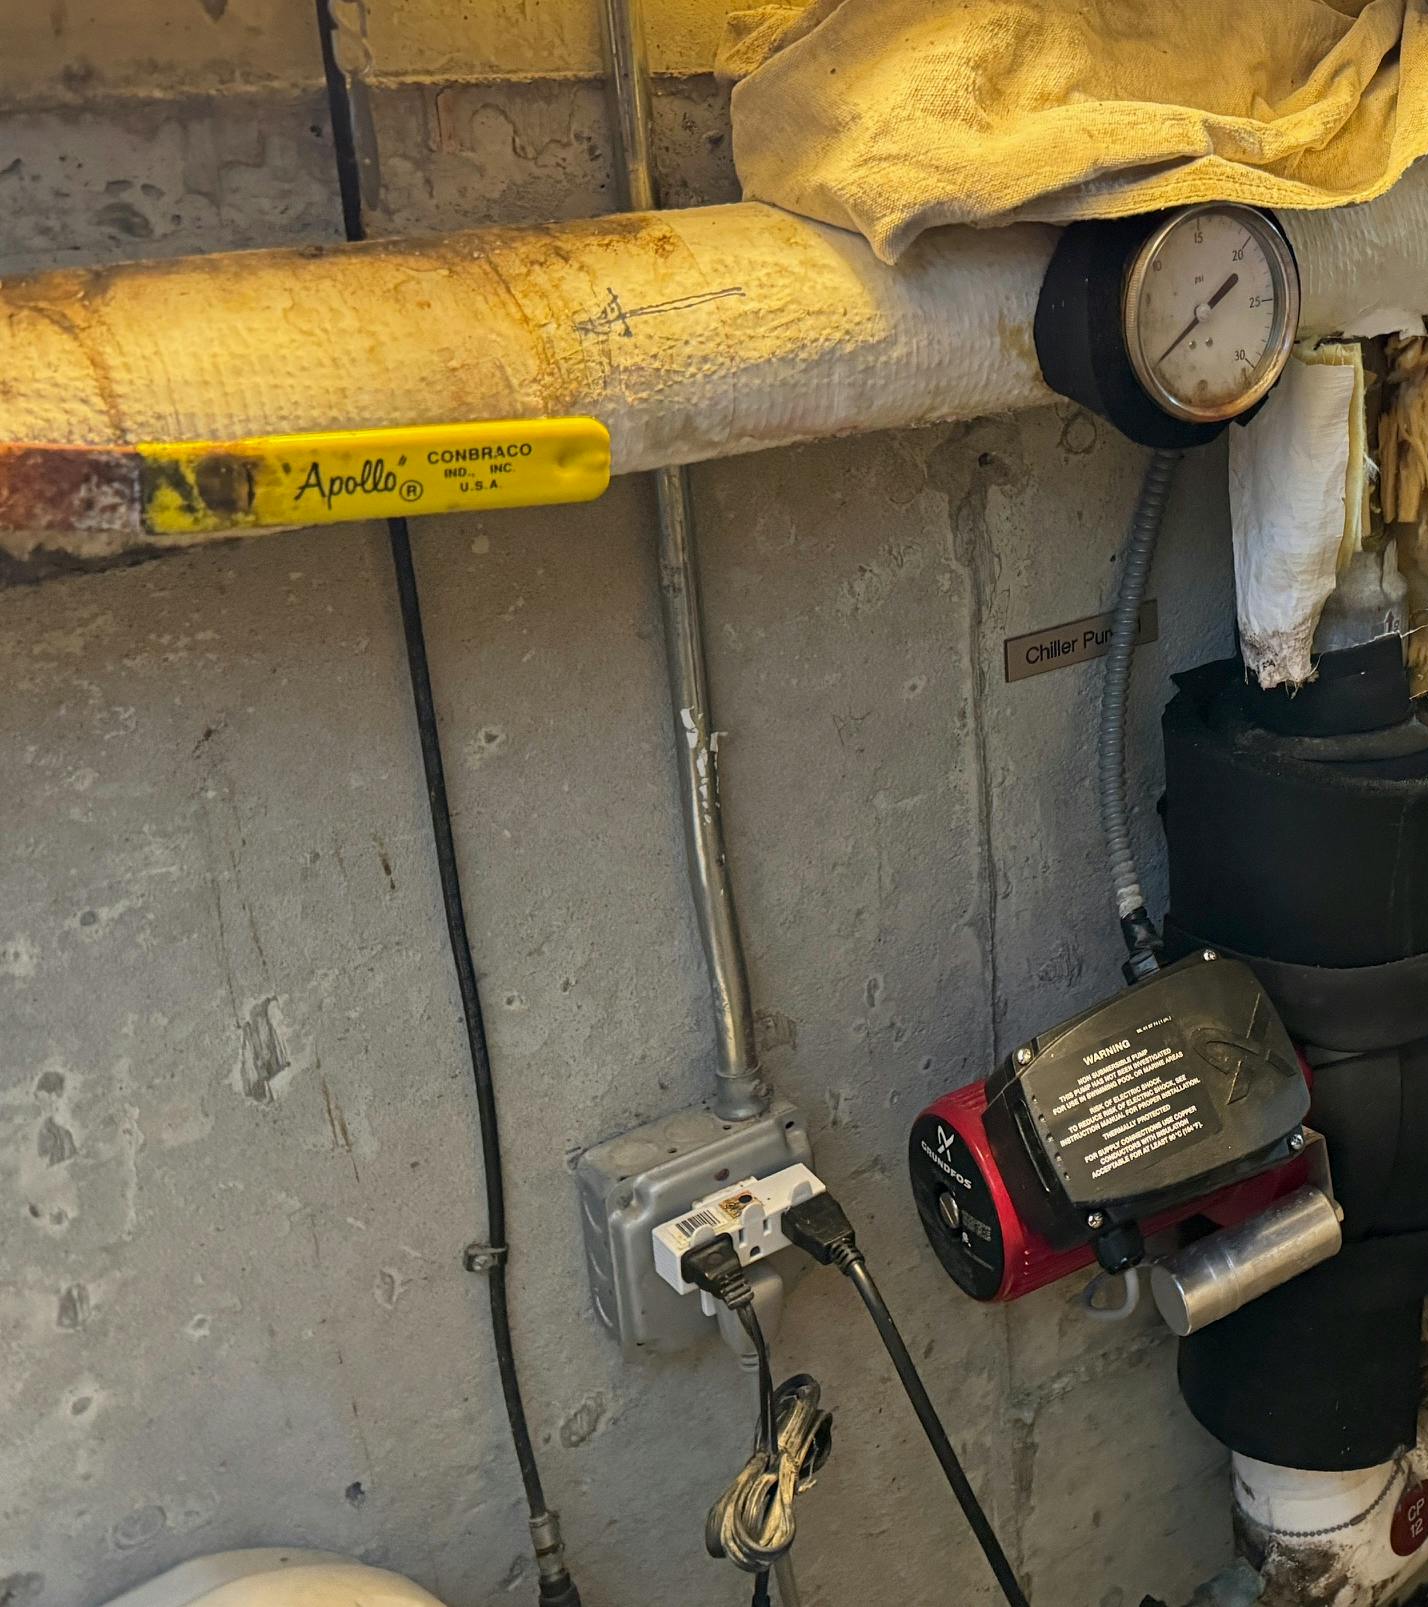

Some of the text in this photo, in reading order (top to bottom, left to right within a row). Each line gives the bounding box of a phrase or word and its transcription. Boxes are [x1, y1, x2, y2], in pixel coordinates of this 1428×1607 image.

[1194, 231, 1203, 244] 15
[1232, 249, 1244, 262] 20
[1194, 274, 1204, 285] psi
[1249, 296, 1261, 309] 25
[1234, 349, 1246, 361] 30
[427, 443, 532, 465] CONBRACO
[1025, 638, 1078, 665] Chiller
[1077, 1074, 1091, 1085] NON
[1130, 1048, 1148, 1061] PUMP
[1082, 1039, 1130, 1065] WARNING
[1052, 1104, 1067, 1115] FOR
[1065, 1098, 1079, 1109] USE
[1078, 1095, 1086, 1103] IN
[1116, 1073, 1134, 1085] POOL
[1133, 1069, 1143, 1077] OR
[1165, 1051, 1183, 1063] AREAS
[1058, 1047, 1171, 1102] THIS PUMP HAS NOT BEEN INVESTIGATED
[1067, 1124, 1078, 1133] TO
[1077, 1112, 1103, 1129] REDUCE
[1102, 1105, 1118, 1117] RISK
[1117, 1101, 1125, 1110] OF
[1125, 1089, 1154, 1106] ELECTRIC
[1174, 1074, 1186, 1083] SEE
[1089, 1076, 1162, 1114] RISK OF ELECTRIC SHOCK
[1059, 1123, 1100, 1147] INSTRUCTION
[1099, 1111, 1126, 1128] MANUAL
[1124, 1105, 1138, 1116] FOR
[1137, 1094, 1162, 1110] PROPER
[1084, 1105, 1197, 1163] FOR SUPPLY CONNECTIONS USE COPPER
[1102, 1104, 1170, 1140] THERMALLY PROTECTED
[921, 1140, 973, 1190] GRUNDFOS
[1091, 1155, 1130, 1179] ACCEPTABLE
[1129, 1149, 1143, 1160] FOR
[1142, 1145, 1150, 1154] AT
[1149, 1136, 1168, 1150] LEAST
[1099, 1140, 1141, 1165] CONDUCTORS
[1140, 1133, 1156, 1145] WITH
[1408, 1498, 1425, 1522] CP
[1410, 1518, 1424, 1538] 12
